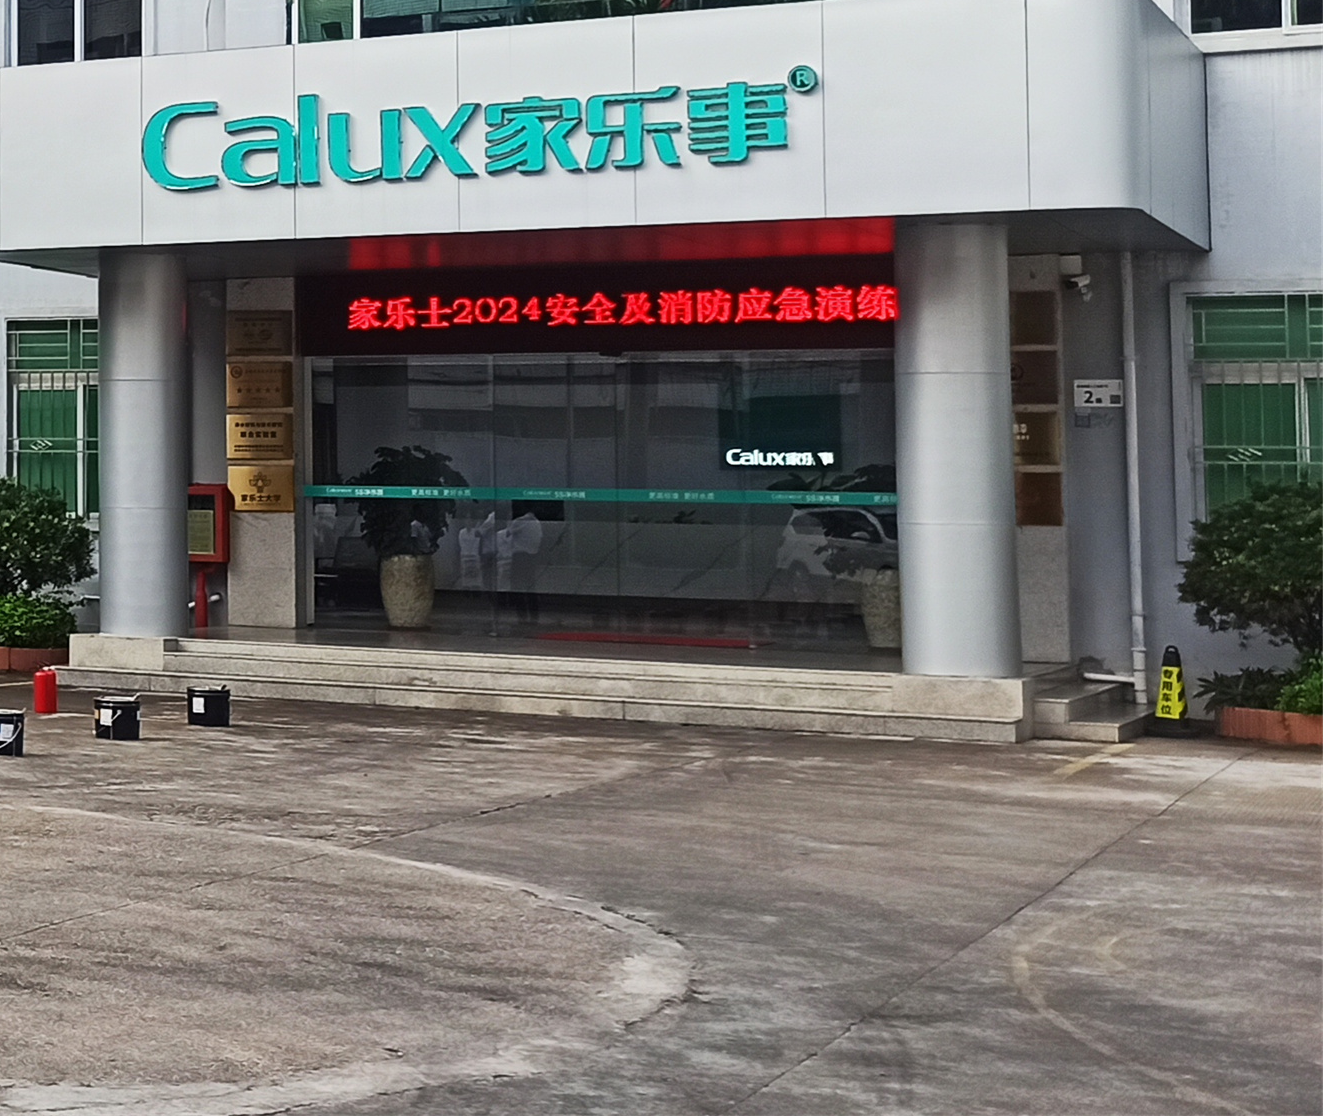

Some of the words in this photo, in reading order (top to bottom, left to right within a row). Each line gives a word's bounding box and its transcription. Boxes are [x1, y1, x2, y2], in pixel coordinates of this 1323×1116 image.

[347, 284, 900, 331] 家乐士2024安全及消防应急演练
